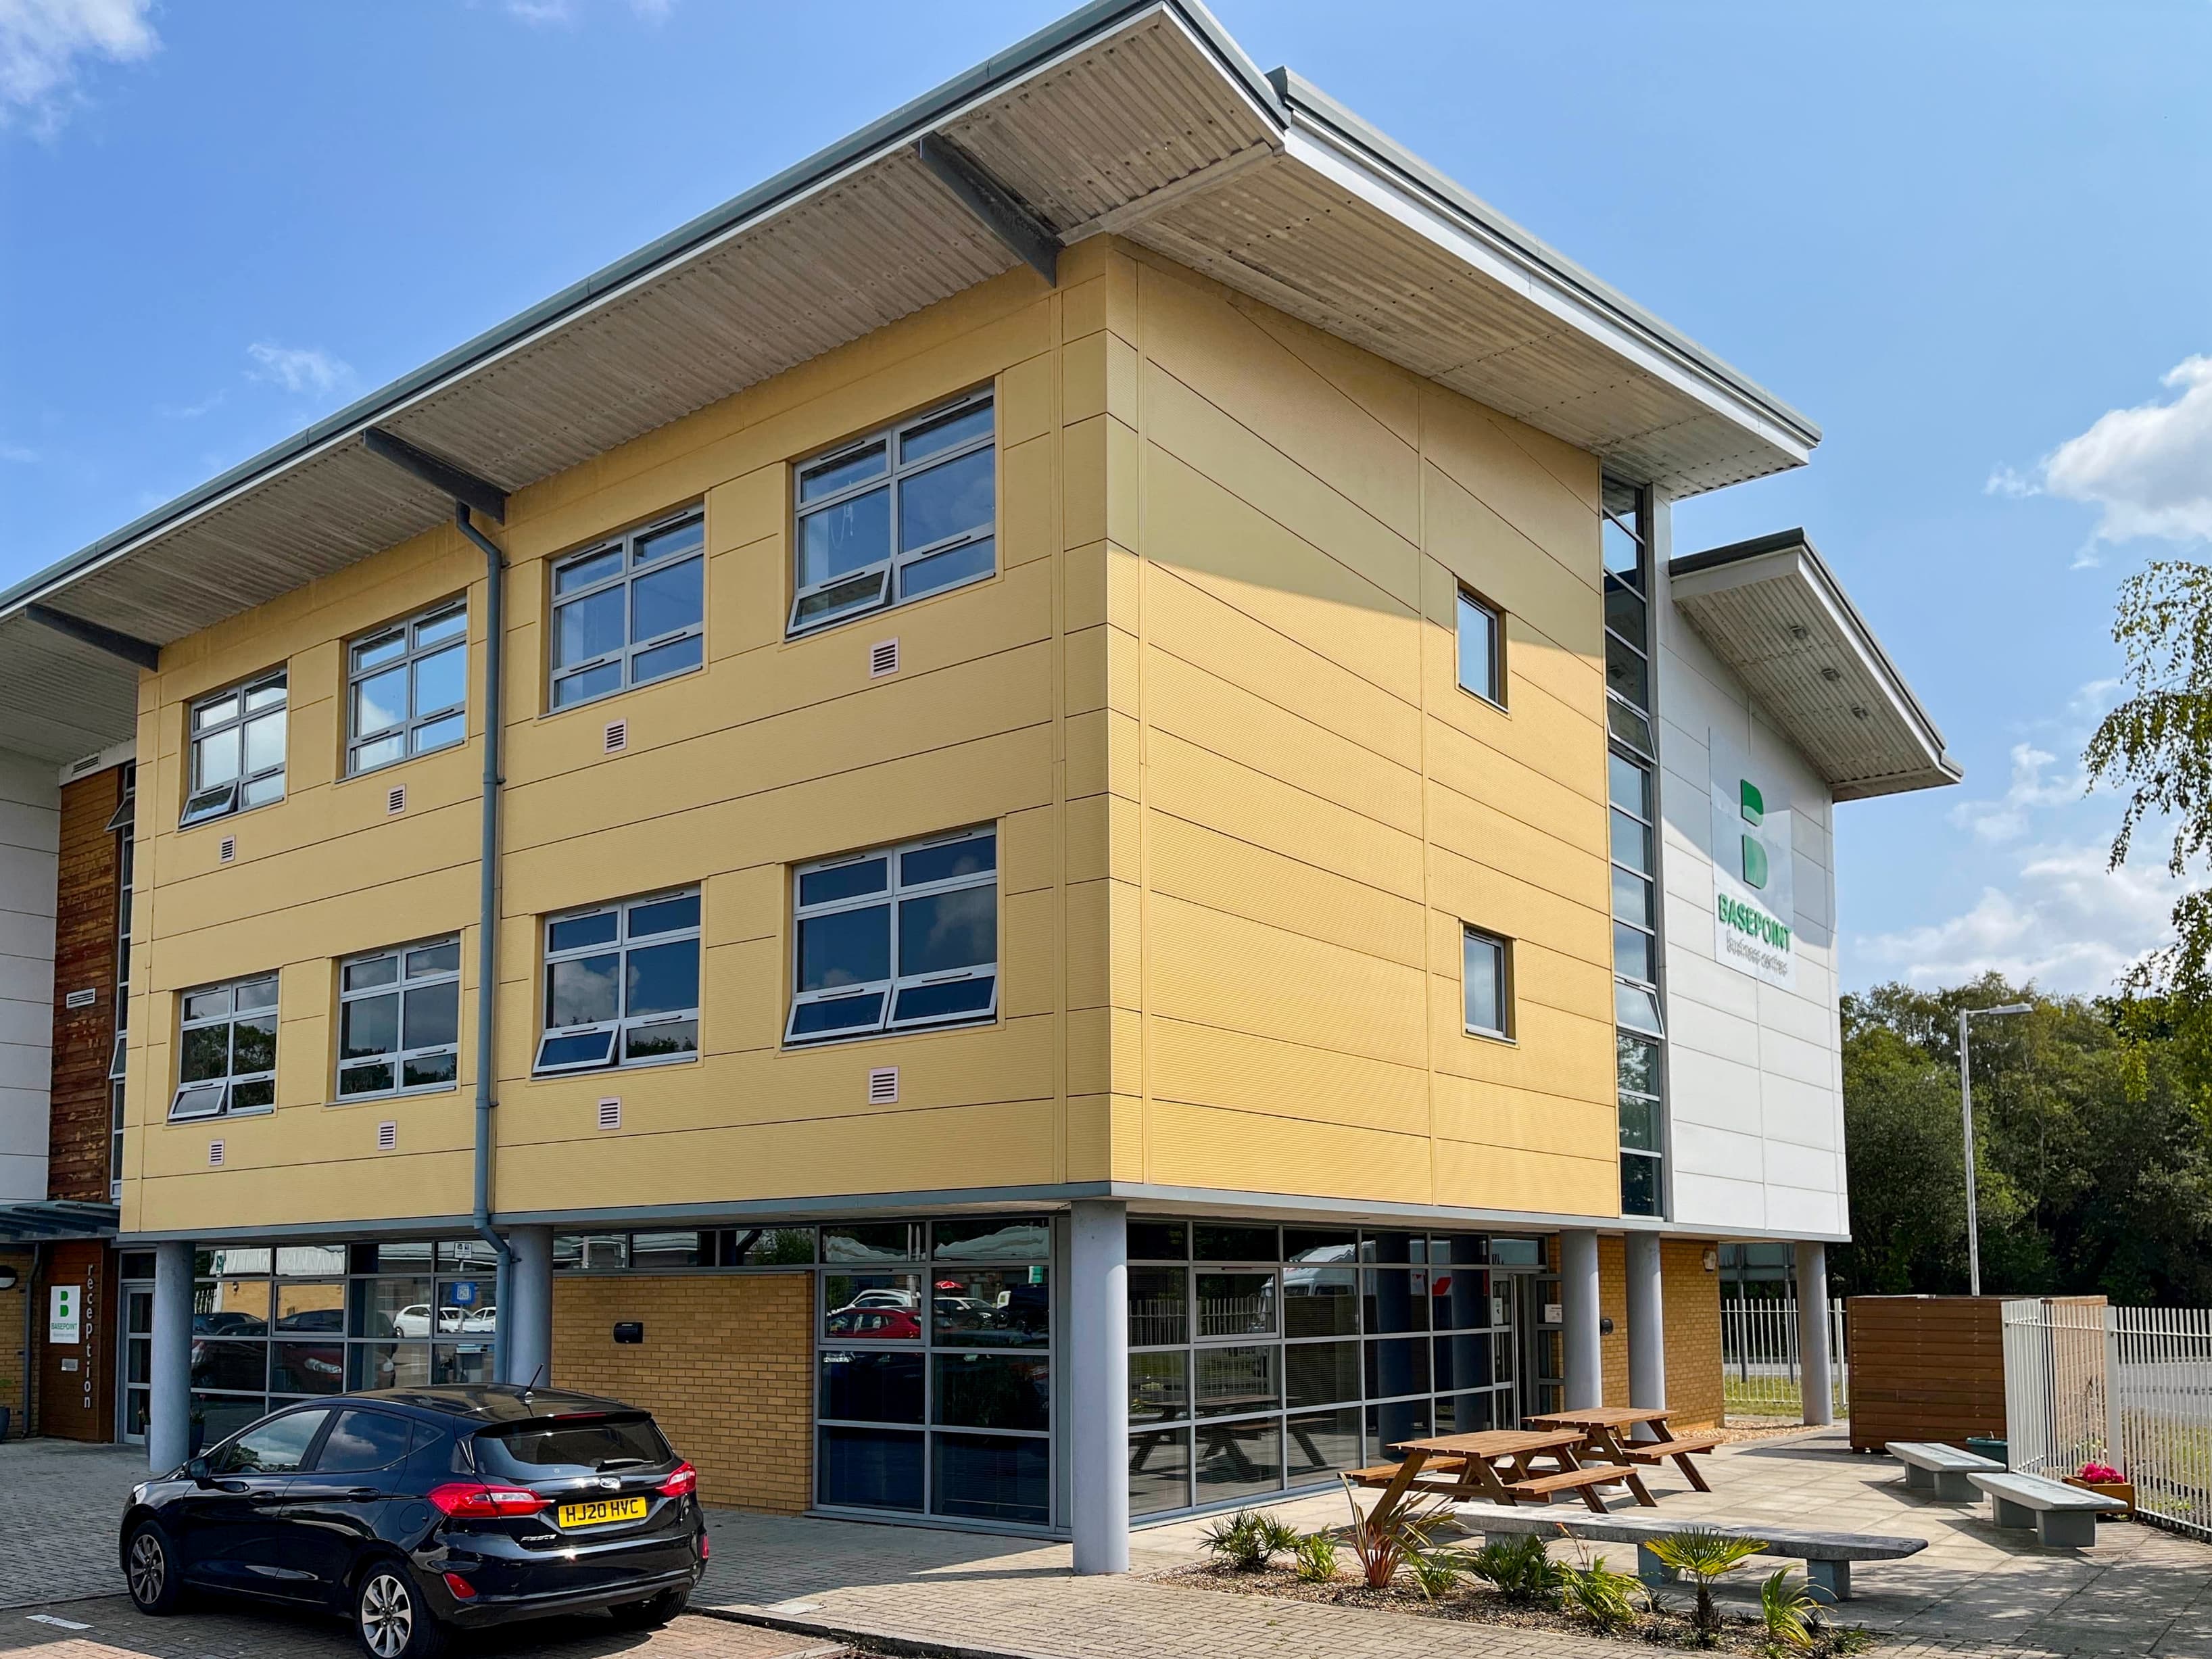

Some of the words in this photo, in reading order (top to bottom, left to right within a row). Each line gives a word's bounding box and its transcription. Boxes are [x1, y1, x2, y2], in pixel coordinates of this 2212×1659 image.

[1718, 892, 1792, 954] BASEPOINT
[51, 1322, 78, 1330] BASEPOINT
[84, 1264, 94, 1409] reception
[565, 1503, 606, 1522] HJ20
[610, 1499, 639, 1517] HVC
